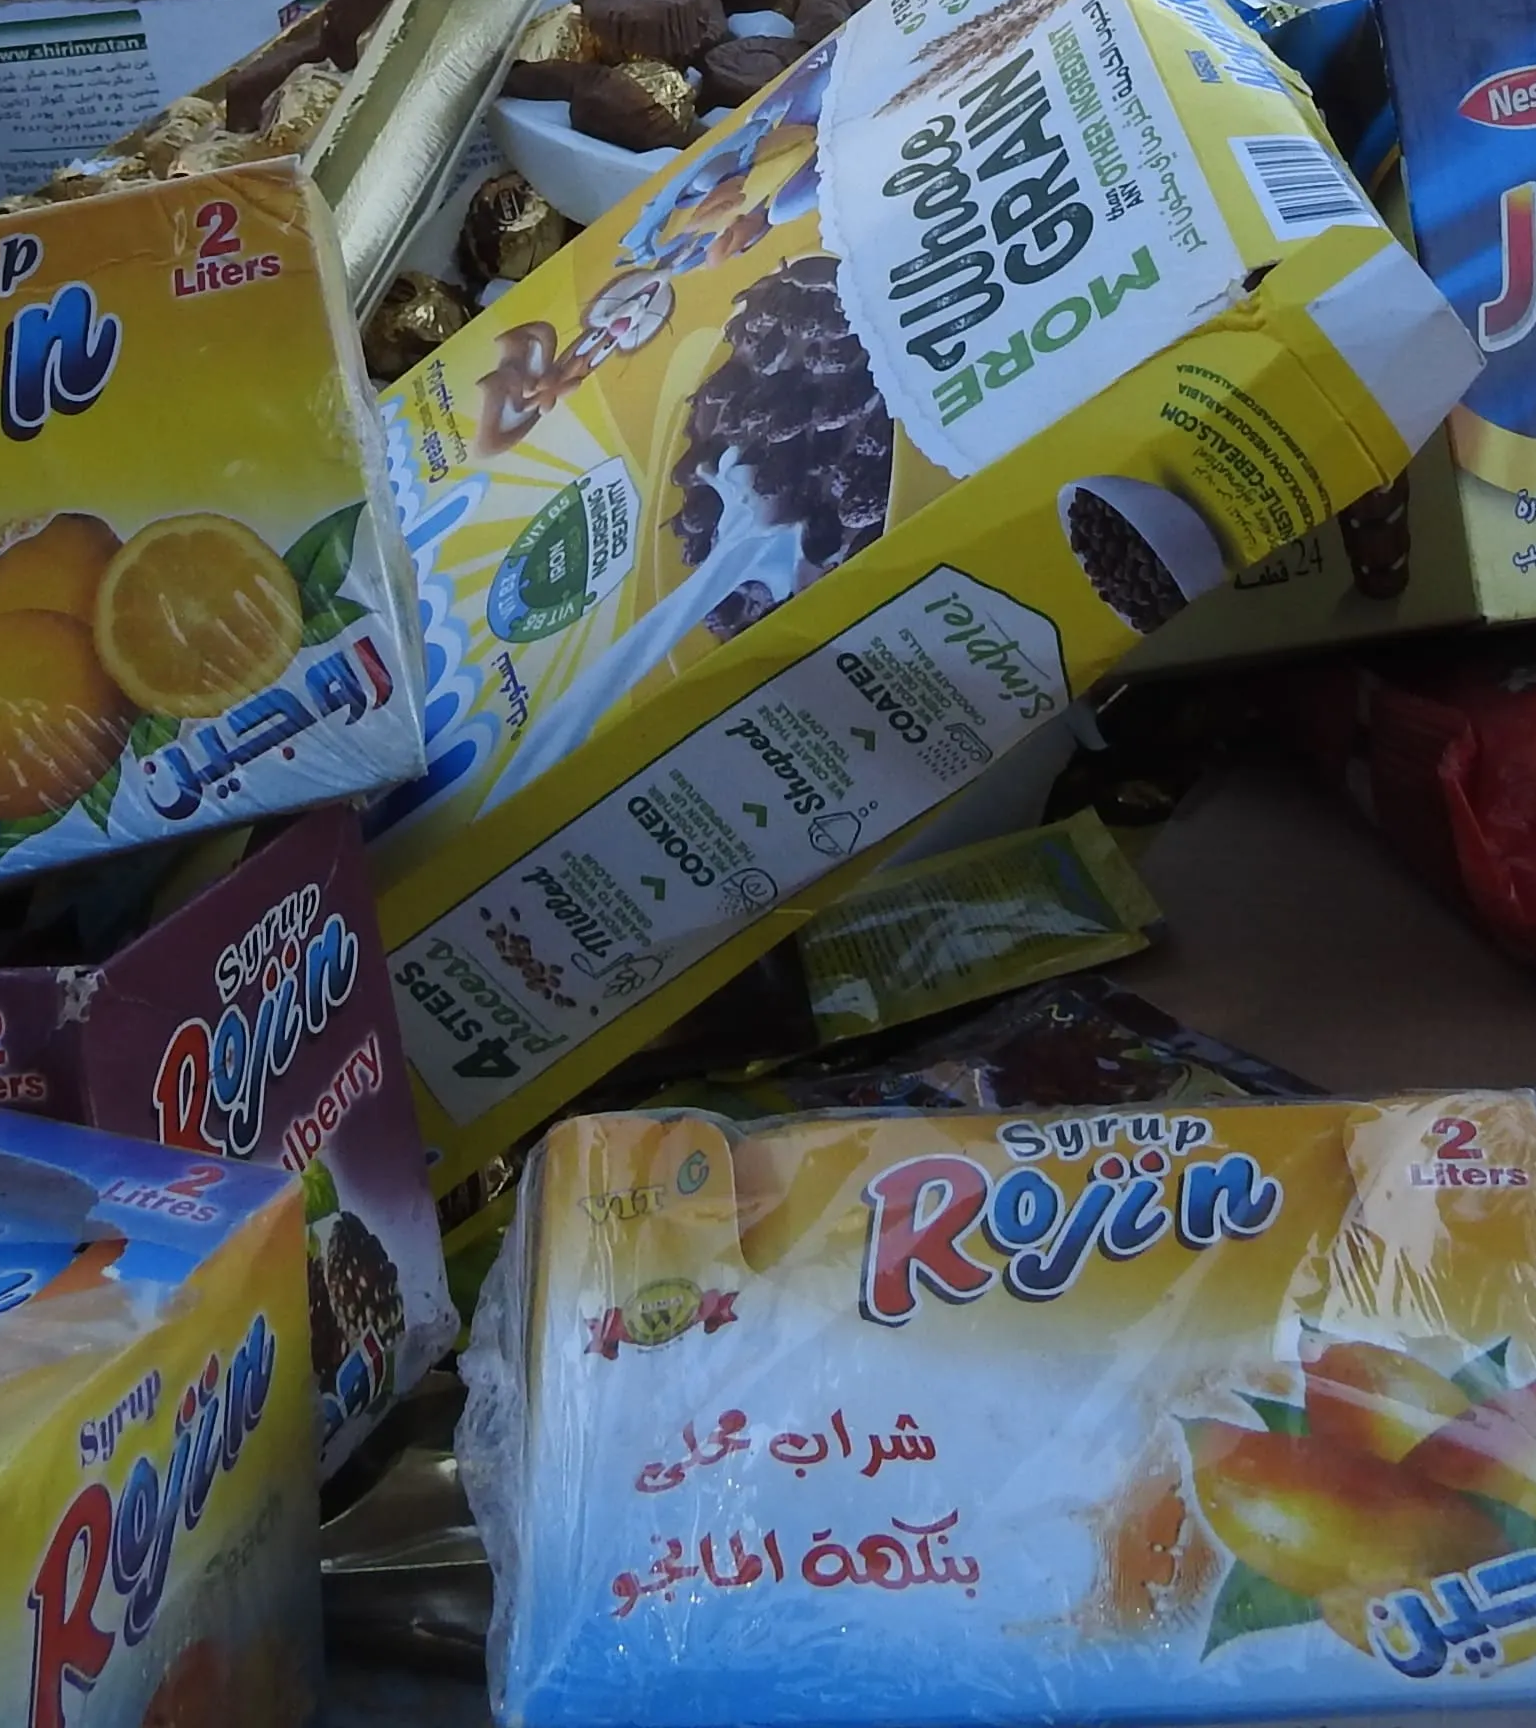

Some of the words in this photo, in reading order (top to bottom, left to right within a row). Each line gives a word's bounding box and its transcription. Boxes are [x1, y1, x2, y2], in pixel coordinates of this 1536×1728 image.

[1048, 22, 1104, 124] INGREDIENT
[959, 48, 1094, 286] GRAIN
[1082, 112, 1127, 187] OTHER
[1118, 180, 1144, 210] ANY
[196, 202, 242, 254] 2
[882, 114, 1004, 372] Whole
[173, 249, 282, 299] Liters
[932, 245, 1161, 428] MORE
[520, 520, 546, 552] VIT
[587, 487, 609, 581] NOURISHING
[607, 478, 629, 560] CREATIVITY
[548, 539, 566, 584] IRON
[1294, 536, 1324, 576] 24
[549, 601, 575, 628] VIT
[756, 703, 793, 742] THOSE
[773, 701, 809, 739] BALLS
[835, 652, 928, 745] COATED
[136, 635, 394, 823] روجين
[825, 737, 851, 764] YOU
[726, 718, 826, 815] Shaped
[788, 739, 830, 782] CREATE
[669, 789, 687, 808] UP
[627, 795, 716, 888] COOKED
[558, 868, 598, 909] WHOLE
[559, 849, 599, 890] WHOLE
[580, 851, 616, 889] FLOUR
[521, 865, 615, 959] Milled
[596, 889, 614, 907] TO
[614, 887, 654, 930] GRAINS
[215, 883, 321, 1000] Syrup
[612, 906, 652, 948] GRAINS
[395, 961, 483, 1044] STEPS
[152, 914, 360, 1156] Rojin
[451, 1035, 522, 1078] 4
[997, 1110, 1208, 1162] Syrup
[1431, 1116, 1480, 1160] 2
[184, 1163, 228, 1199] 2
[674, 1150, 710, 1197] C
[1410, 1159, 1531, 1190] Liters
[102, 1179, 220, 1226] Litres
[859, 1153, 1285, 1328] Rojin
[80, 1369, 163, 1468] Syrup
[769, 1411, 939, 1474] شراب
[29, 1314, 276, 1728] Rojin
[802, 1506, 985, 1598] بنكهة
